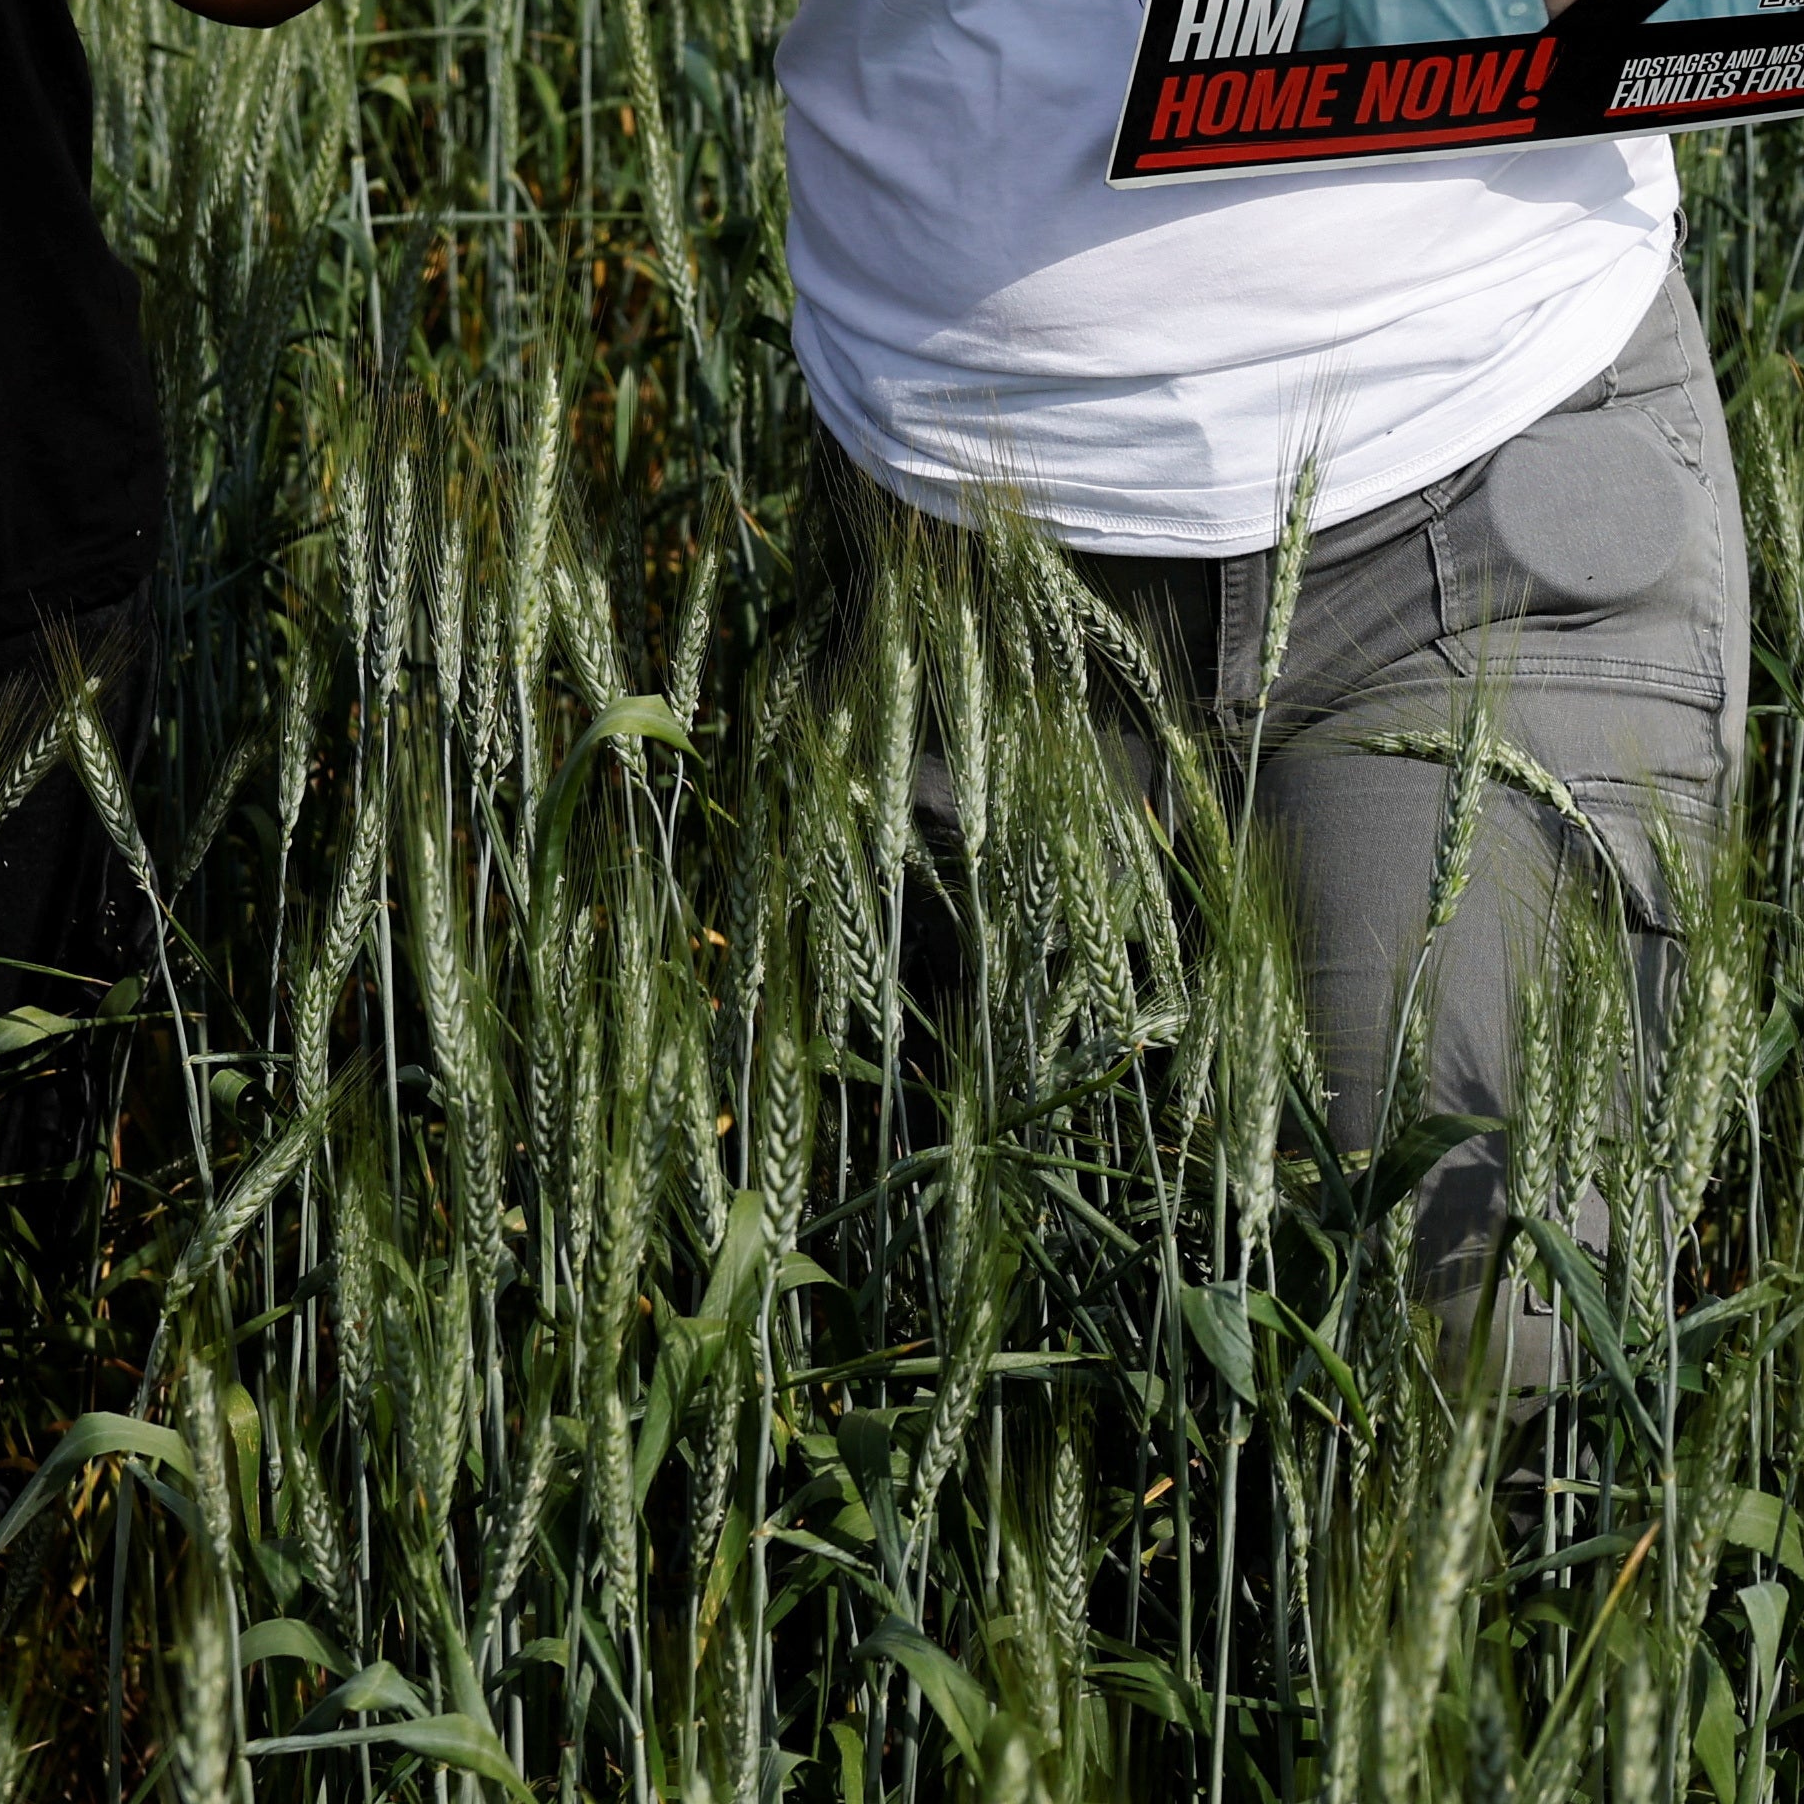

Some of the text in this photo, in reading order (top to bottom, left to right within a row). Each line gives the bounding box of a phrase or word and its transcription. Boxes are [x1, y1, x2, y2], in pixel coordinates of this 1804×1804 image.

[1619, 51, 1724, 80] HOSTAGES
[1722, 47, 1767, 71] AND
[1149, 36, 1558, 142] HOME NOW!
[1609, 70, 1743, 110] FAMILIES
